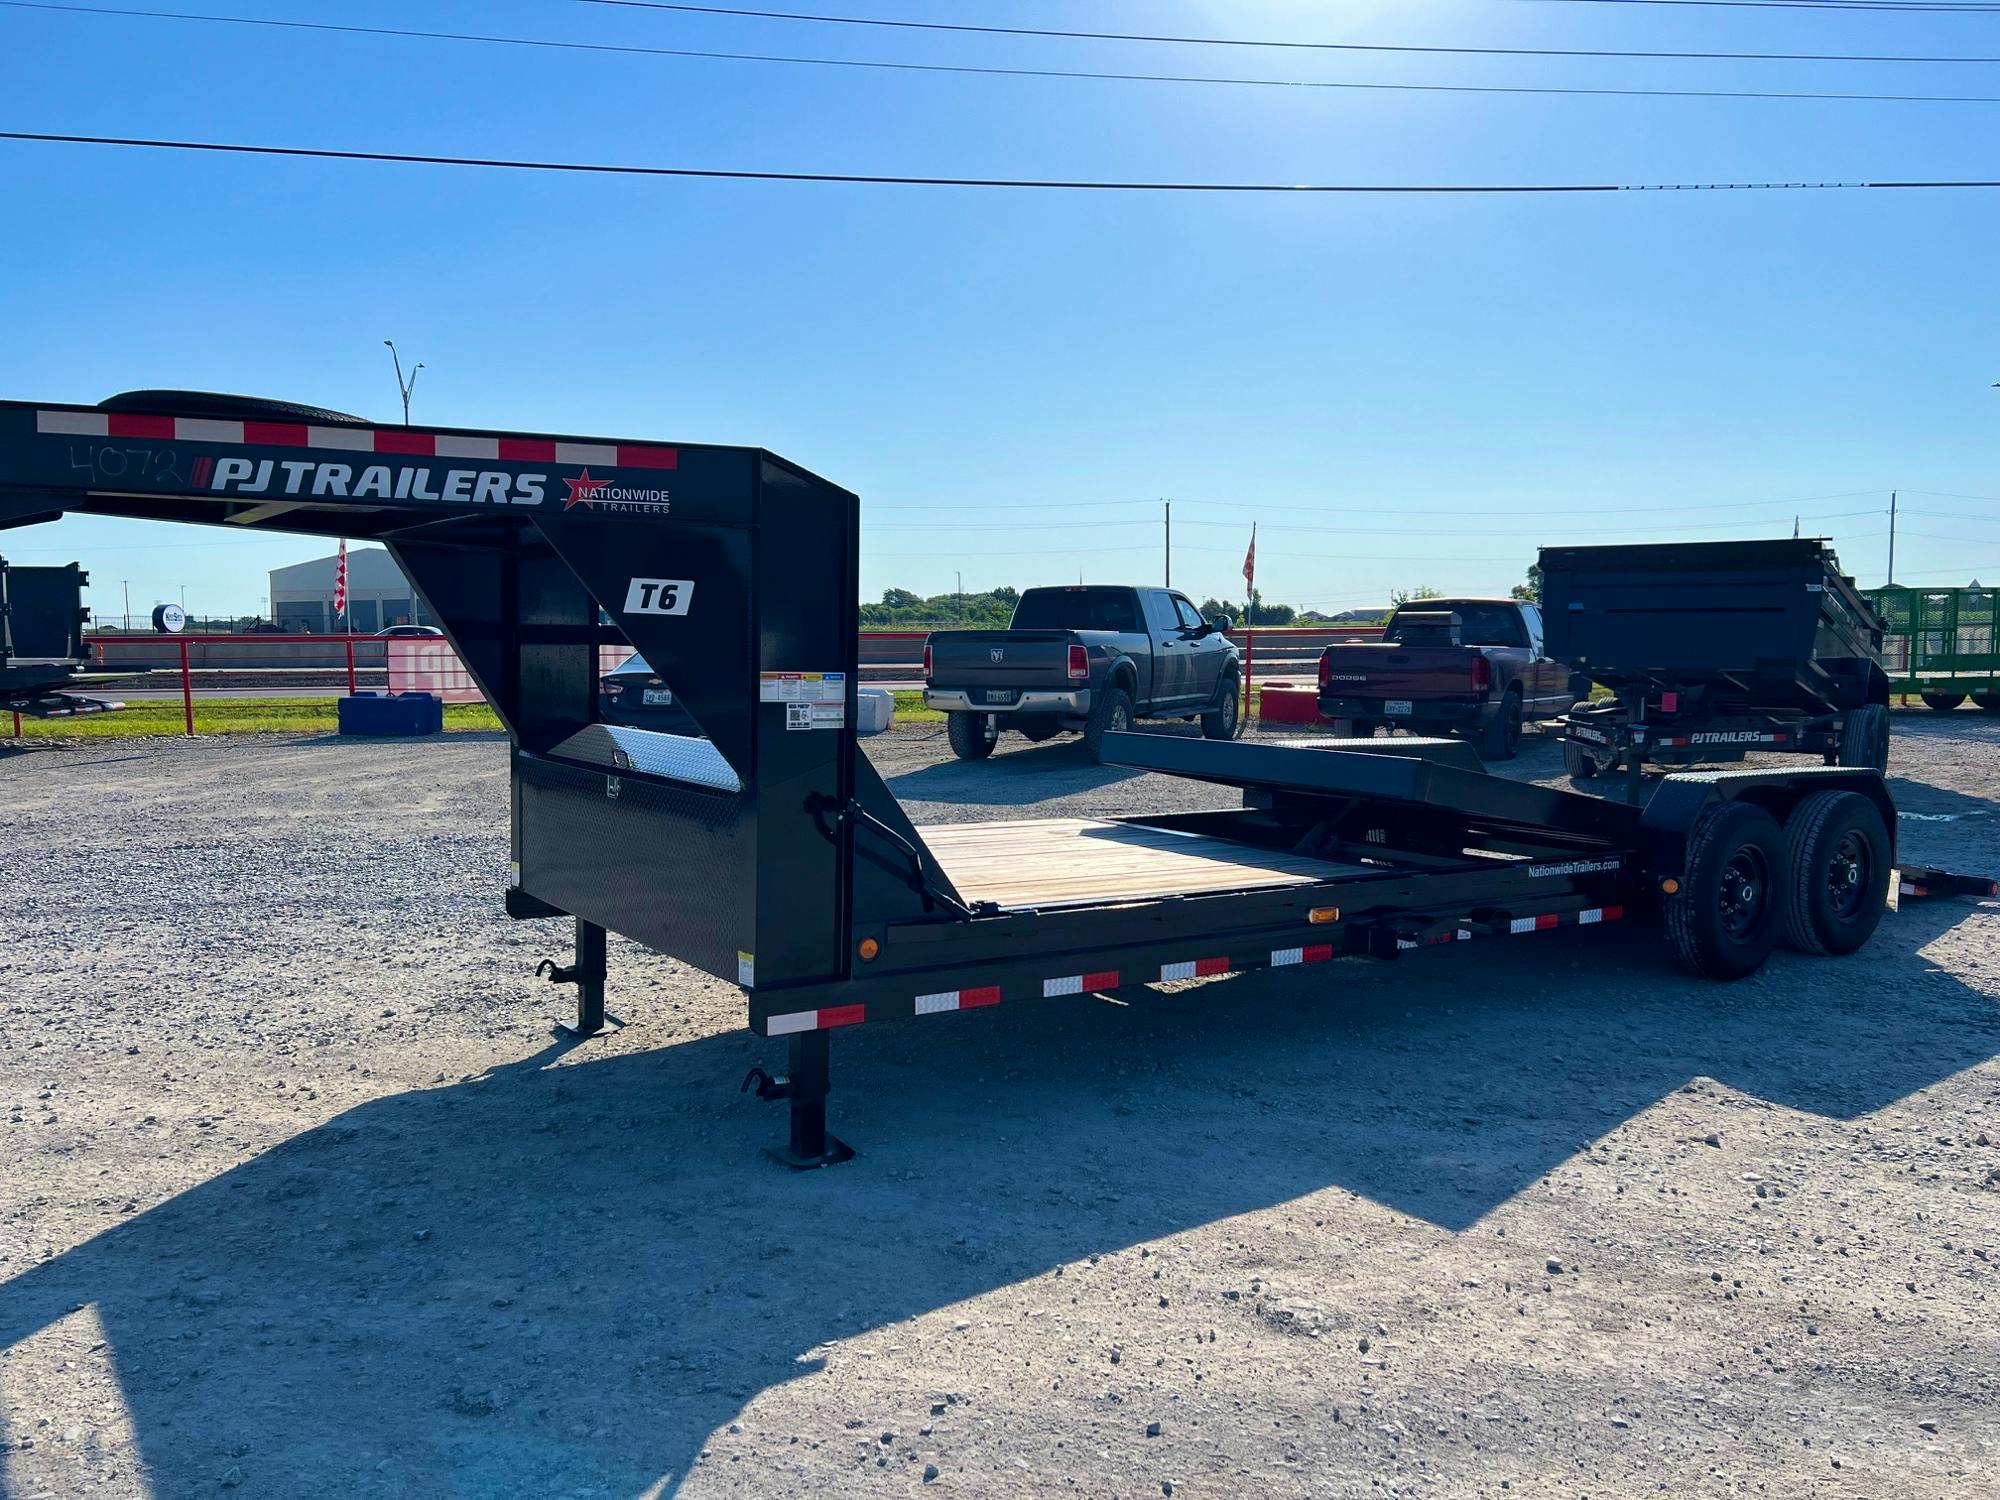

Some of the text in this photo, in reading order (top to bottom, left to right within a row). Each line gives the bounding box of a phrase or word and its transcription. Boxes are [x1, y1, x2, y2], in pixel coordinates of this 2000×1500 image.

[69, 445, 183, 483] 4072
[578, 486, 670, 502] NATIONWIDE
[602, 502, 670, 514] TRAILERS
[640, 583, 679, 610] T6
[1528, 860, 1620, 878] NationwideTrailers.com
